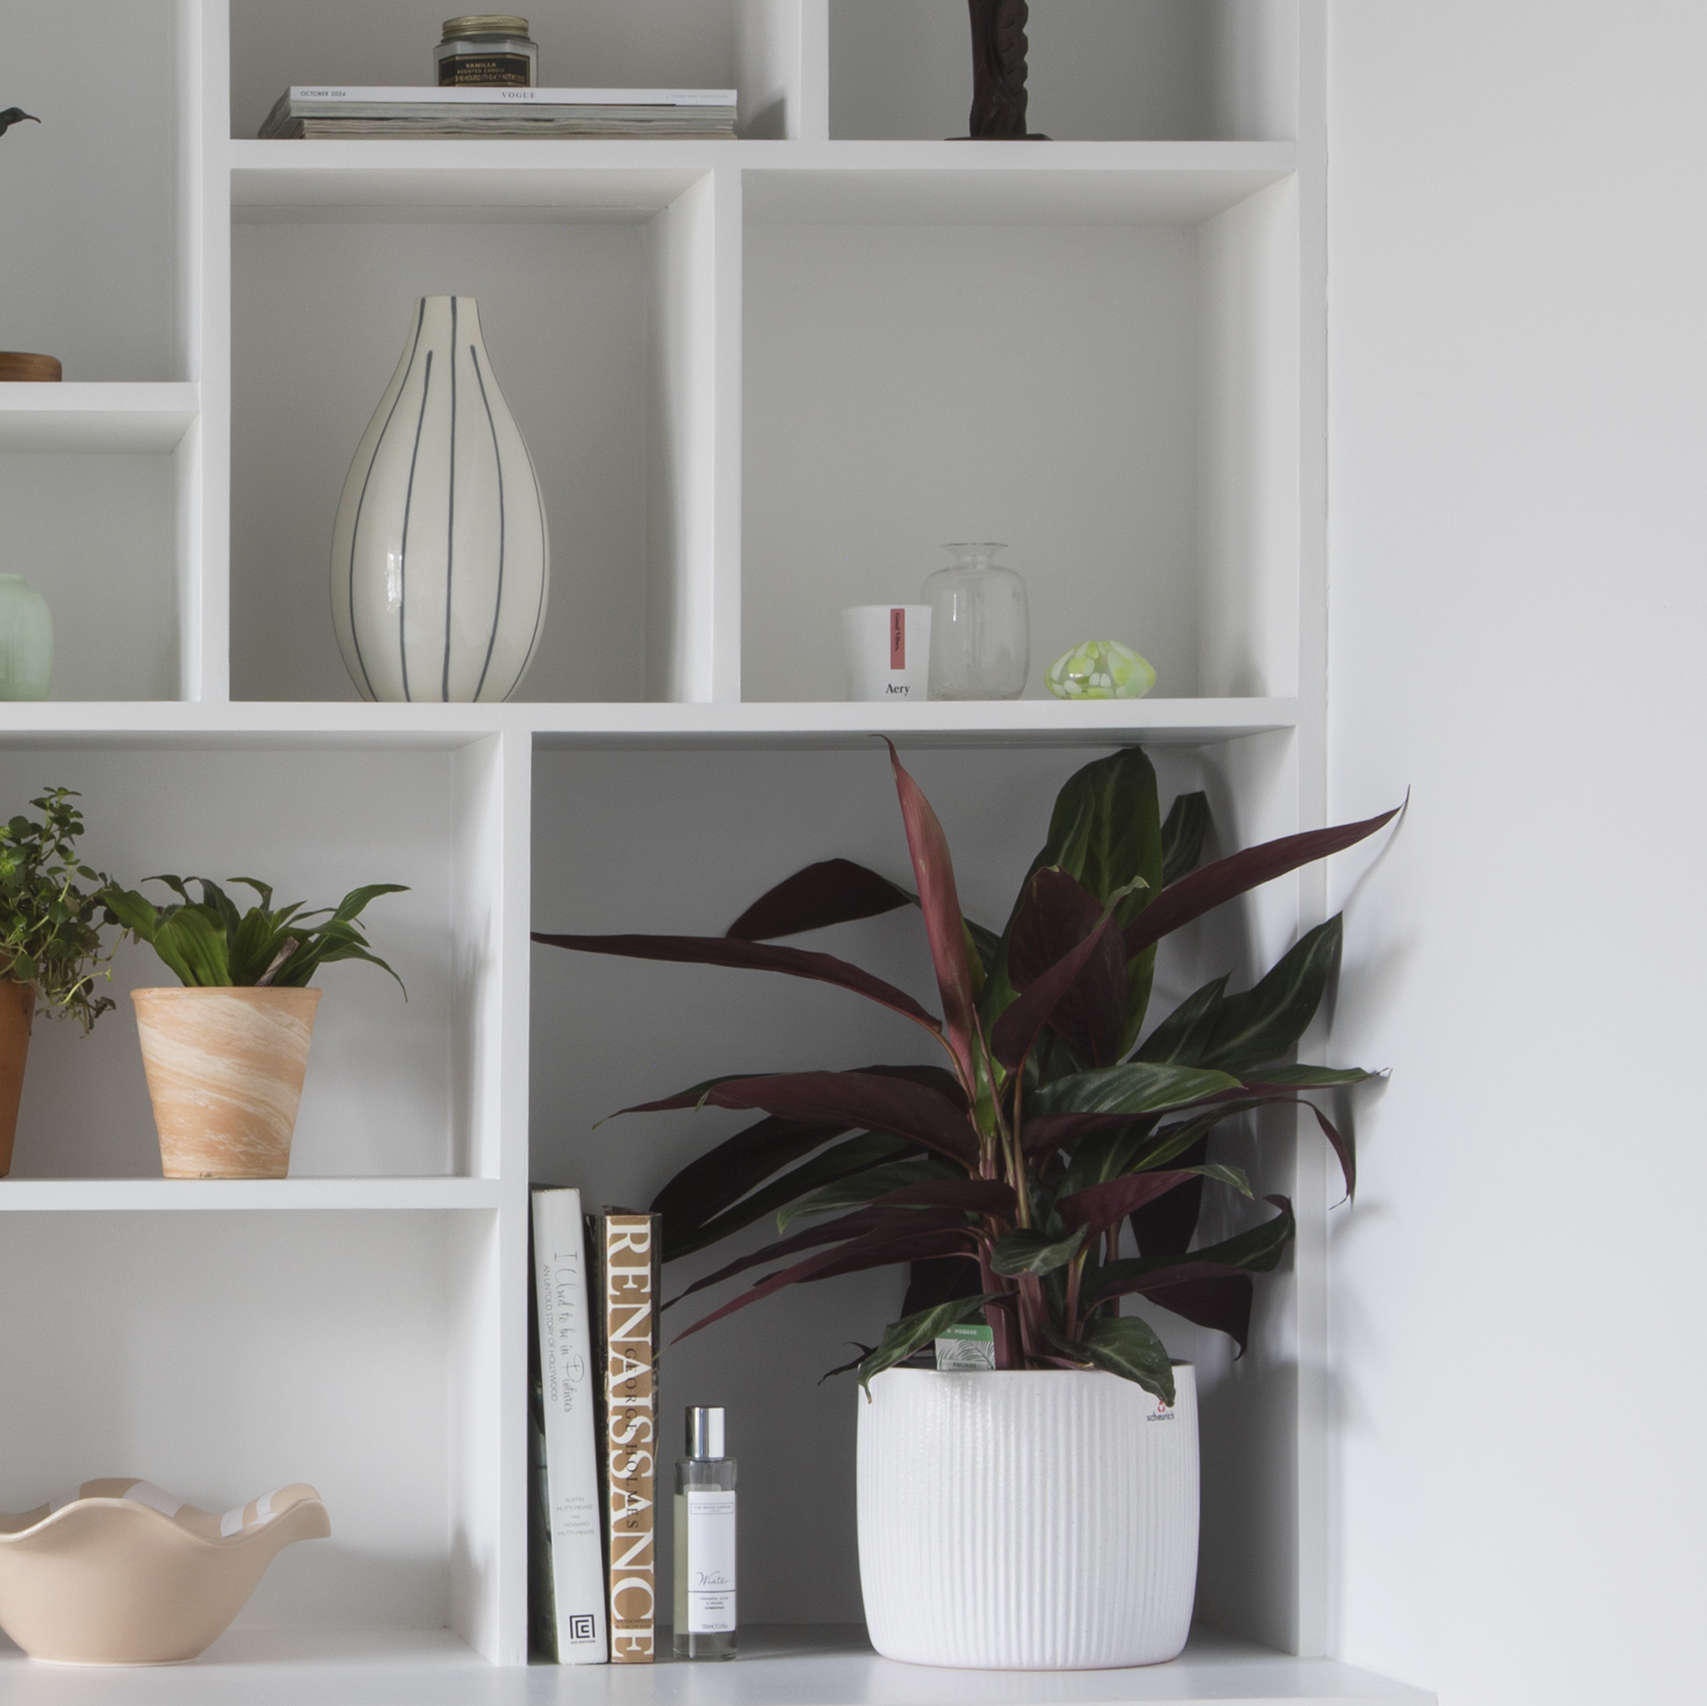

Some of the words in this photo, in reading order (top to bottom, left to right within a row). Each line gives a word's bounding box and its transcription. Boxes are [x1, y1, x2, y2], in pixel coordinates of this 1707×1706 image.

[885, 683, 911, 697] Aery
[554, 1251, 578, 1261] I
[543, 1264, 550, 1277] AN
[544, 1279, 553, 1311] UNTOLD
[554, 1268, 579, 1307] Used
[546, 1312, 555, 1336] STORY
[559, 1312, 574, 1323] to
[559, 1328, 577, 1340] be
[547, 1338, 555, 1348] OF
[560, 1345, 572, 1356] in
[548, 1350, 558, 1402] HOLLYWOOD
[560, 1354, 585, 1413] Pictures
[625, 1348, 637, 1433] GEORGE
[1146, 1411, 1175, 1421] scheurich
[608, 1220, 653, 1658] RENAISSANCE
[626, 1443, 638, 1529] HOLMES
[695, 1570, 730, 1586] Winter
